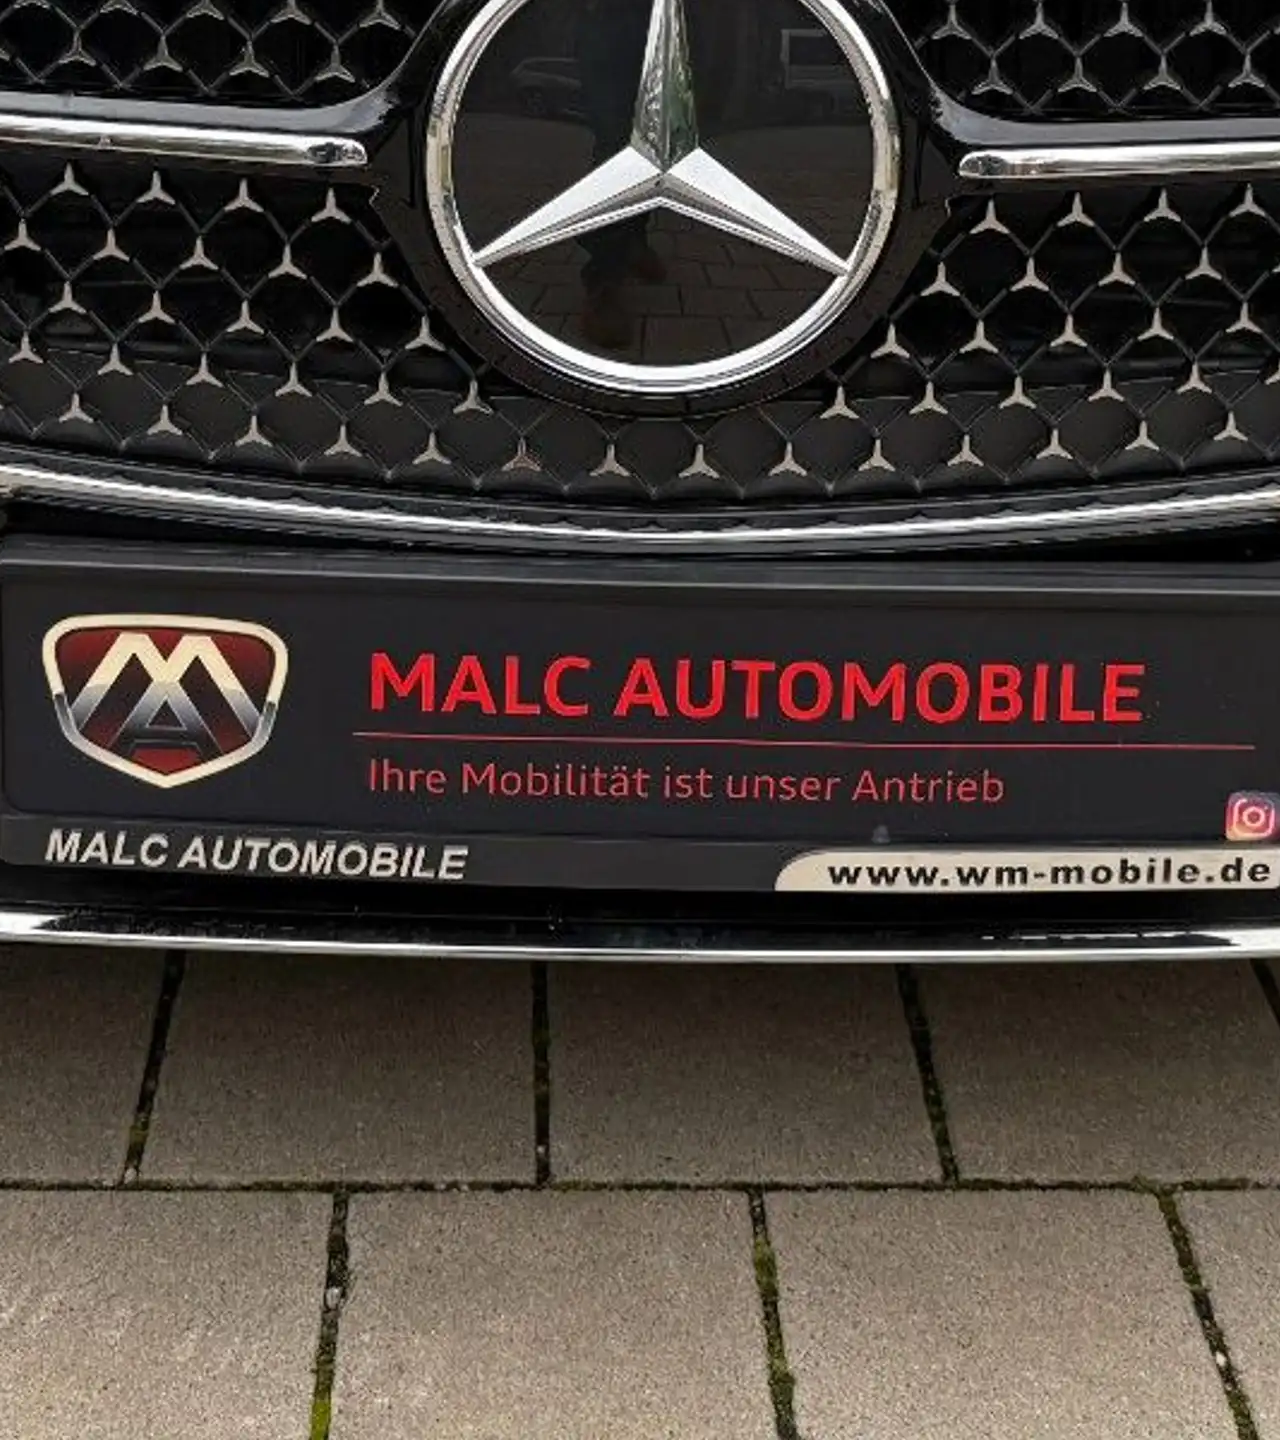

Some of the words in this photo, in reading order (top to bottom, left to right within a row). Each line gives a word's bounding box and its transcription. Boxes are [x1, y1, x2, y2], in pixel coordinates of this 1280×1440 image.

[371, 652, 590, 718] MALC
[613, 657, 1146, 725] AUTOMOBILE
[368, 759, 448, 795] Ihre
[461, 762, 651, 800] Mobilität
[662, 766, 714, 799] ist
[725, 774, 842, 802] unser
[850, 768, 1006, 804] Antrieb
[44, 828, 169, 868] MALC
[177, 835, 470, 881] AUTOMOBILE
[827, 856, 1272, 888] www.wm-mobile.de
